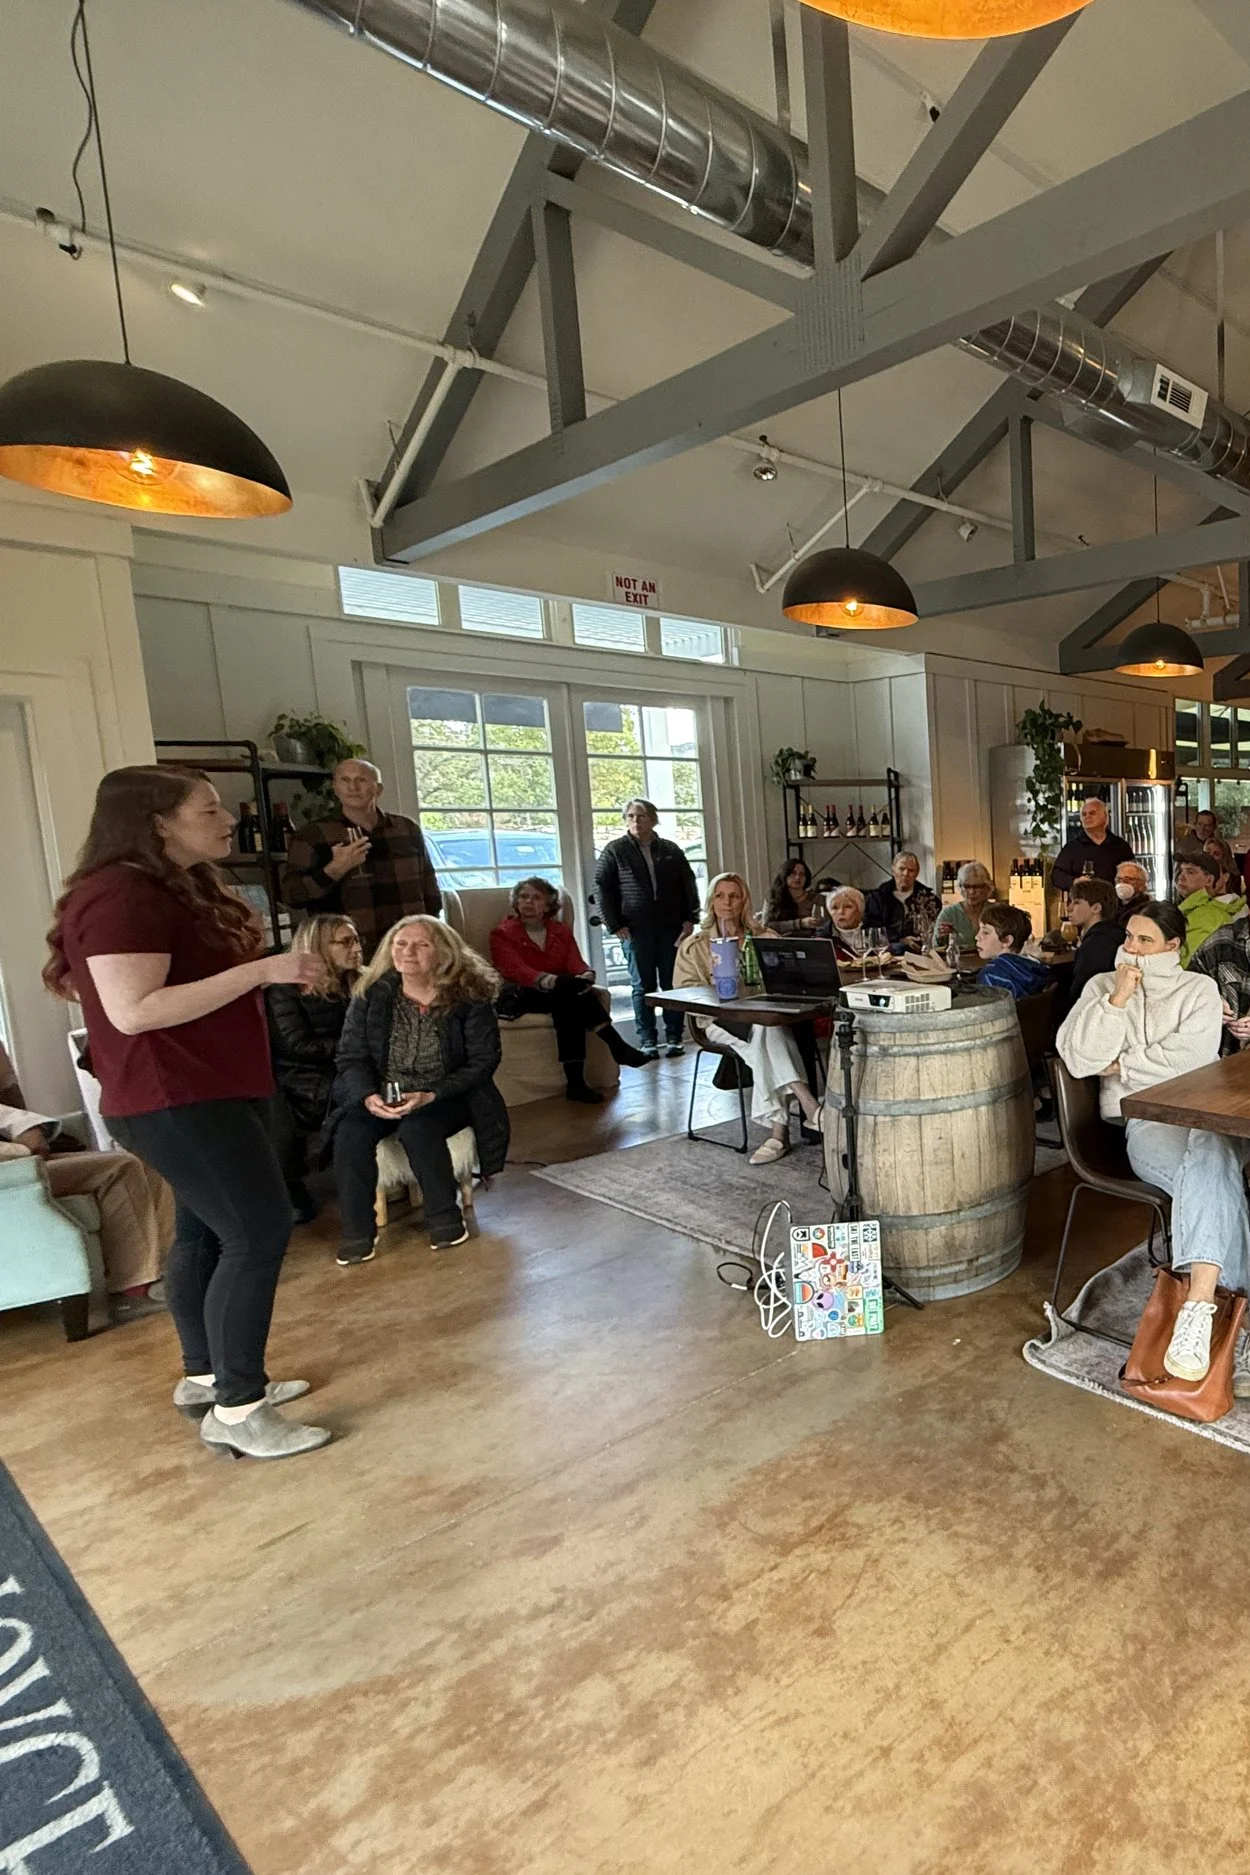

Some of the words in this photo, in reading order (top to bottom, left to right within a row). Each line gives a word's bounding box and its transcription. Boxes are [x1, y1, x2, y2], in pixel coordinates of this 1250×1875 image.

[615, 576, 637, 590] NOT
[641, 580, 656, 593] AN
[625, 591, 649, 605] EXIT
